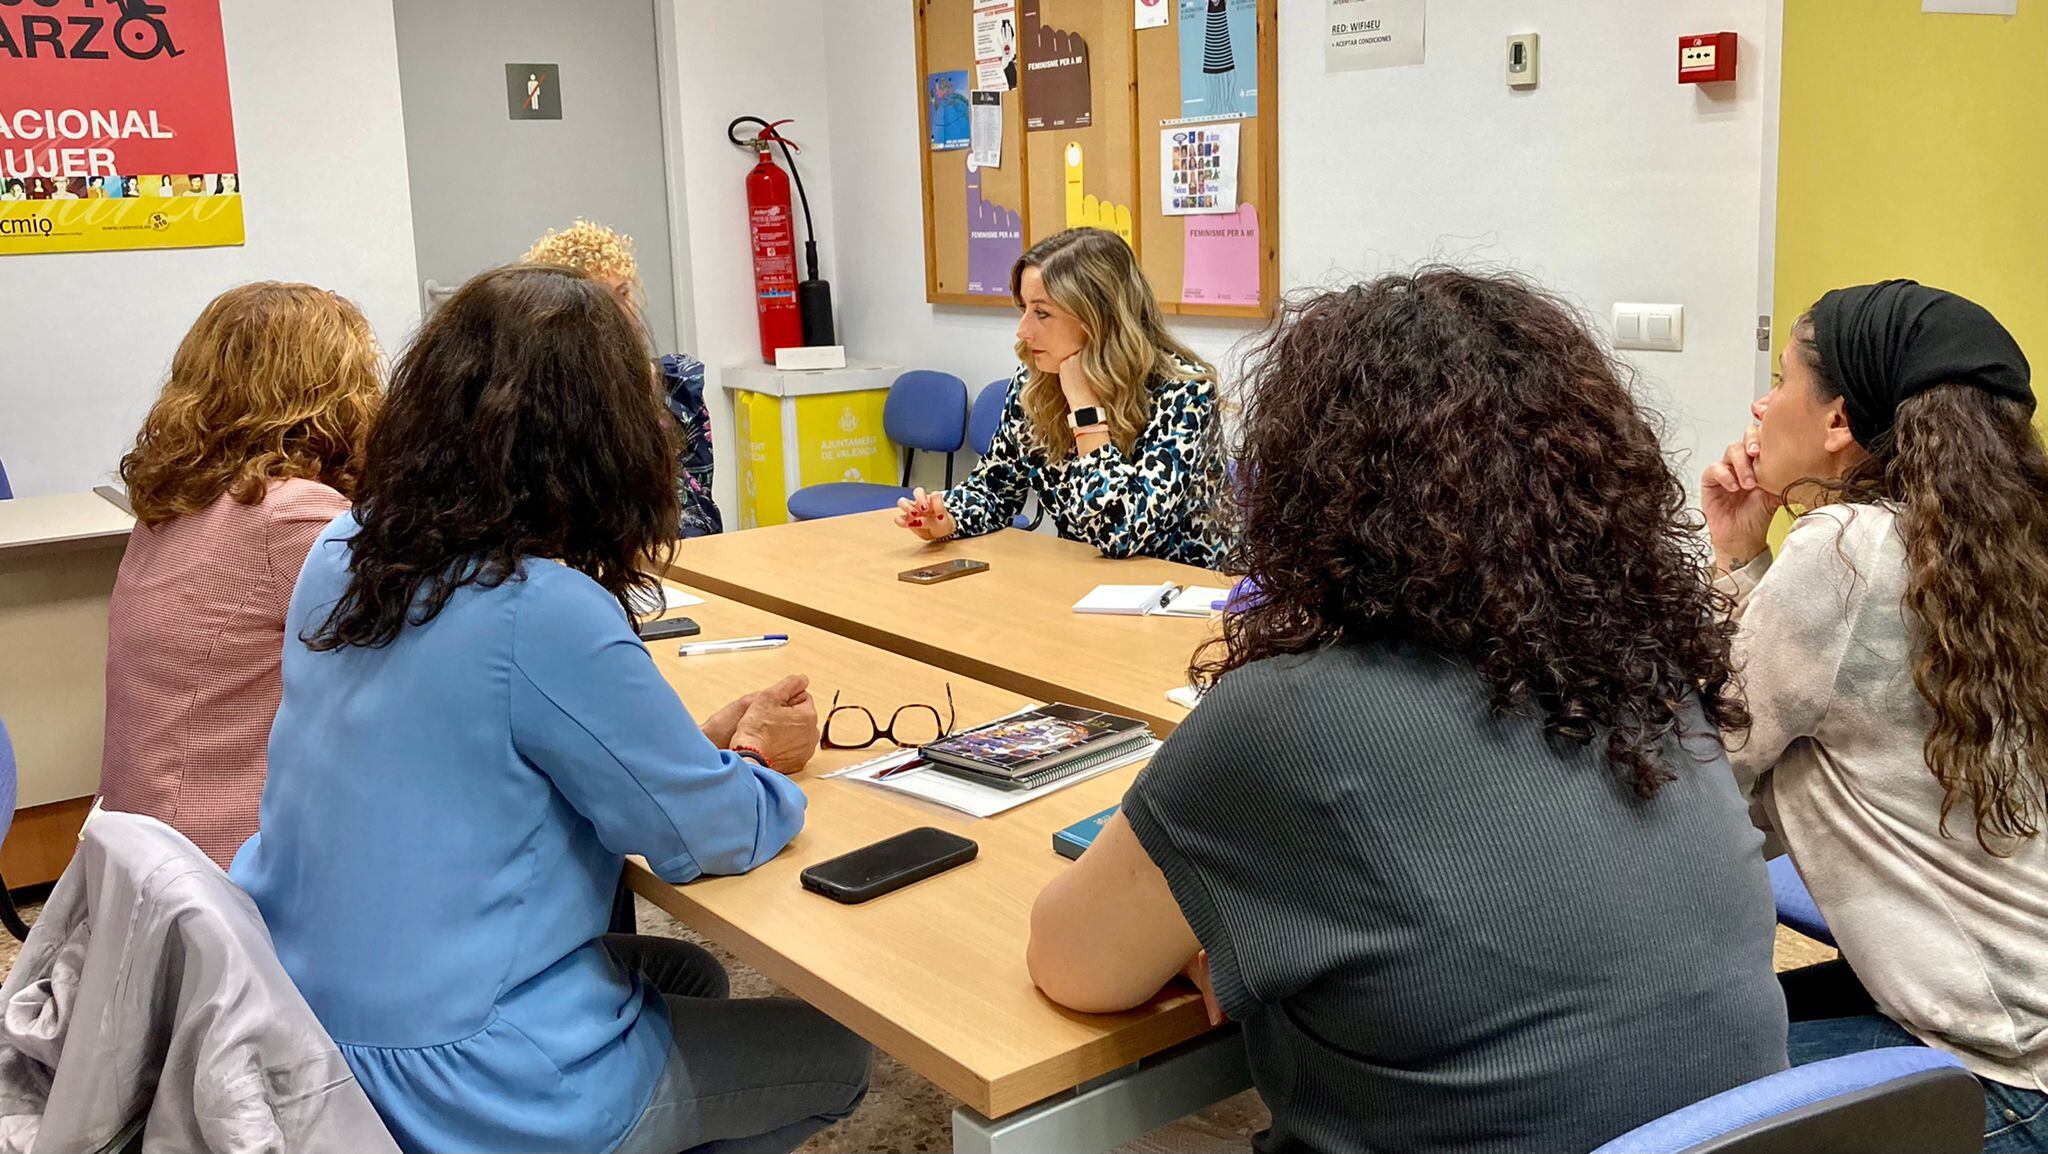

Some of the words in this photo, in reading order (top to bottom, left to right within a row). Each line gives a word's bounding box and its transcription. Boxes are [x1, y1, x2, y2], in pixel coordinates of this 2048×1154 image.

[1332, 23, 1348, 34] RED:
[1350, 19, 1380, 31] WIFI4EU
[1336, 39, 1357, 47] ACEPTAR
[1358, 35, 1391, 45] CONDICIONES
[1028, 59, 1058, 70] FEMINISME
[1060, 57, 1069, 67] PER
[0, 148, 117, 178] UJER
[1190, 229, 1225, 237] FEMINISME
[1227, 229, 1239, 237] PER
[1240, 229, 1245, 237] A
[1246, 229, 1255, 237] MI
[821, 436, 877, 450] AJUNTAMENT
[821, 448, 833, 460] DE
